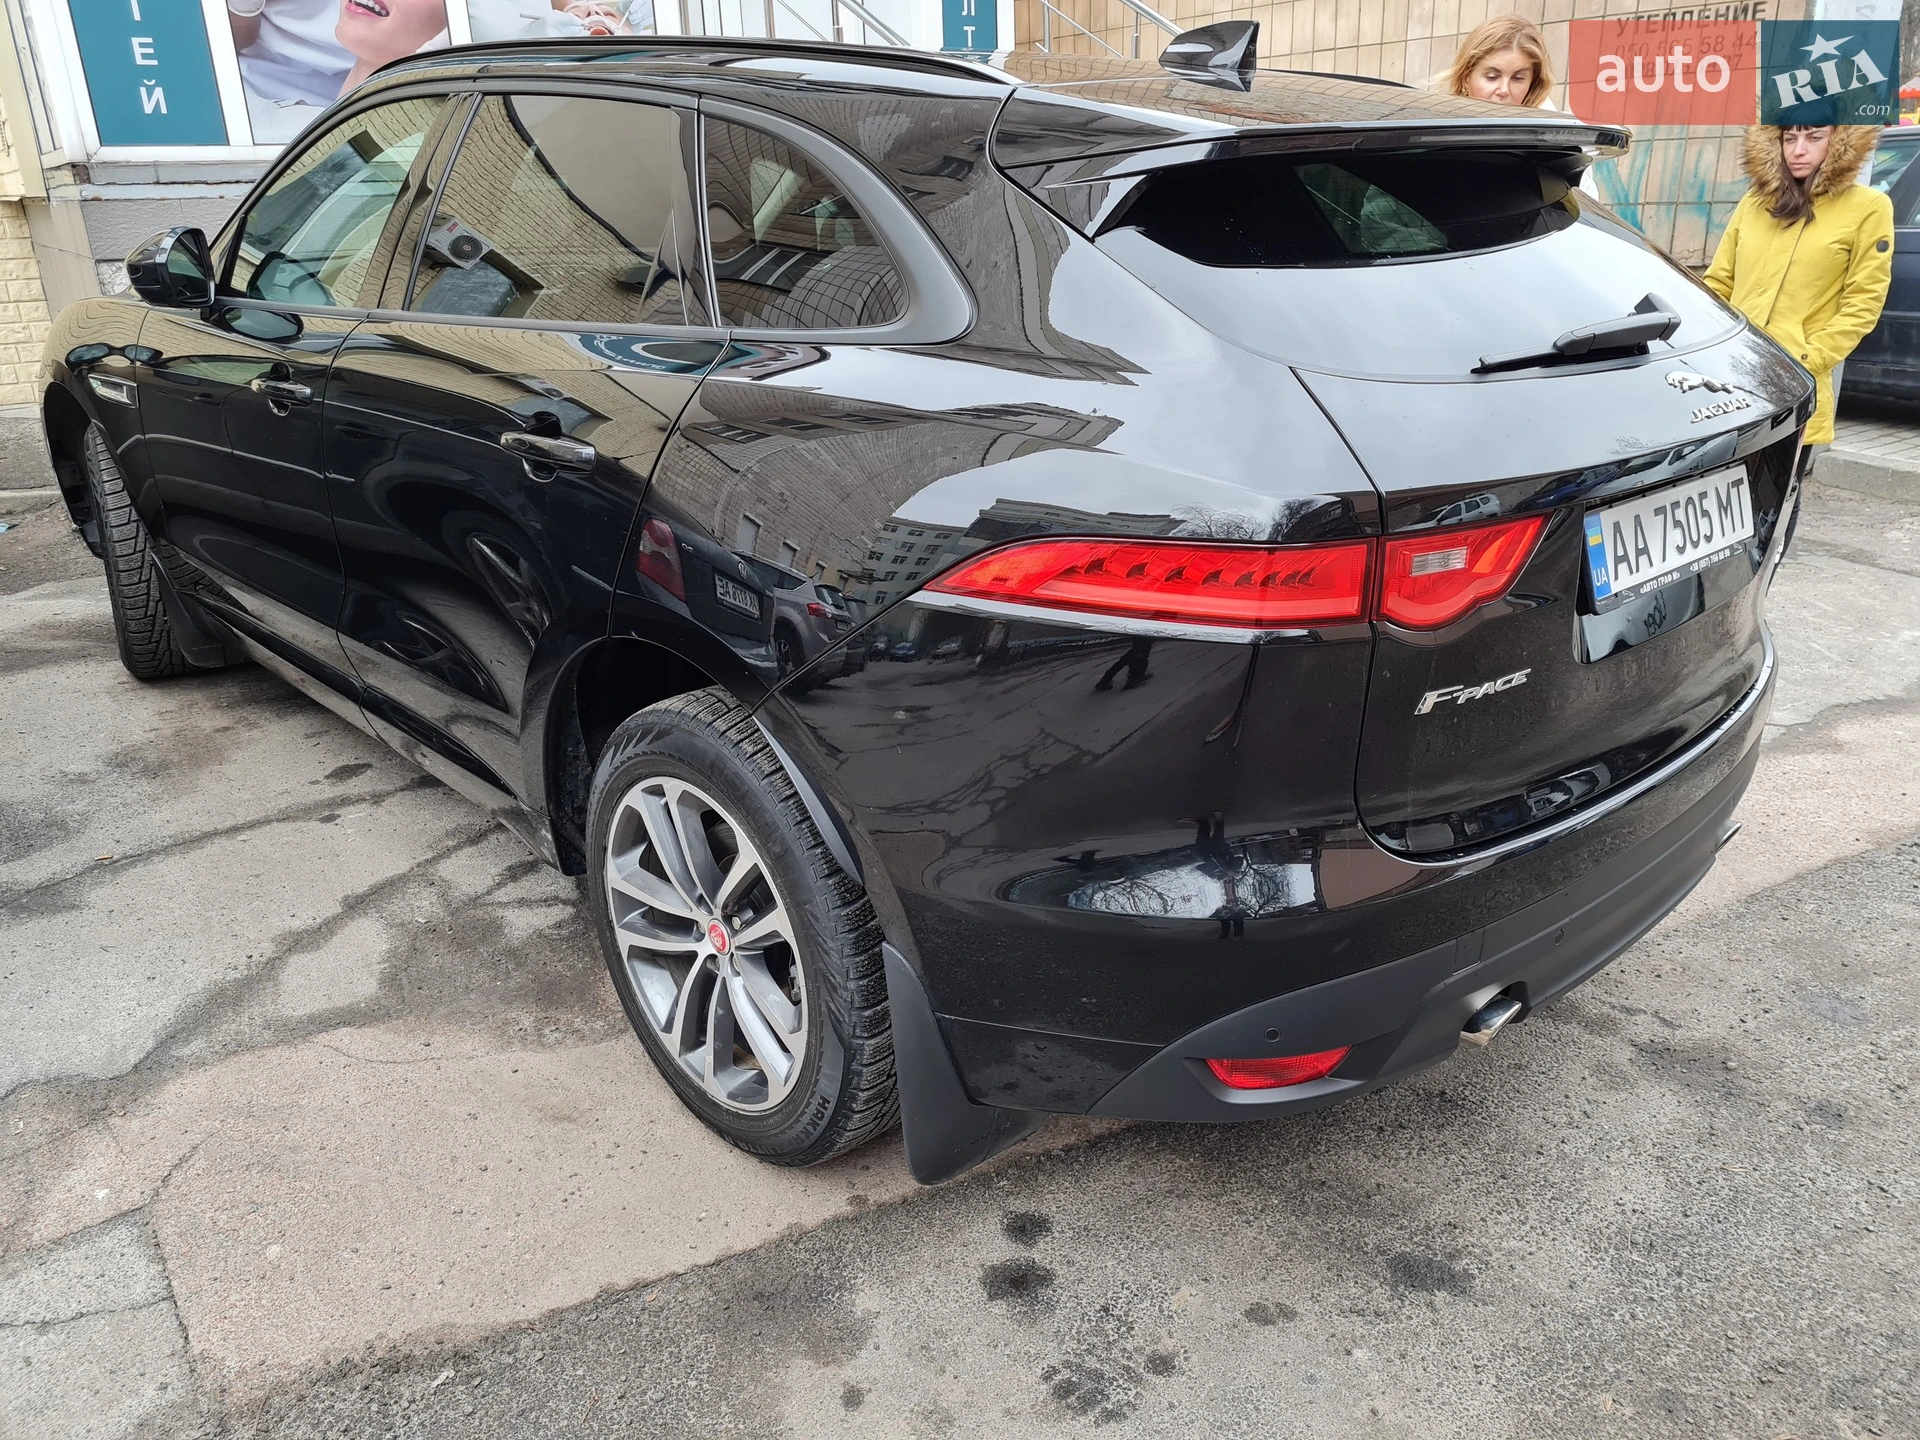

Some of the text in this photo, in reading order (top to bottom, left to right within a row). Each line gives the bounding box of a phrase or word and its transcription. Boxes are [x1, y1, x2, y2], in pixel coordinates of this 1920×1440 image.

[1616, 1, 1768, 37] УТЕПЛЕНИЕ
[1700, 35, 1725, 54] 58
[1691, 398, 1751, 424] JAGUAR
[1613, 477, 1744, 581] AA 7505 MT
[1593, 567, 1609, 586] UA
[1414, 668, 1532, 715] F-PACE
